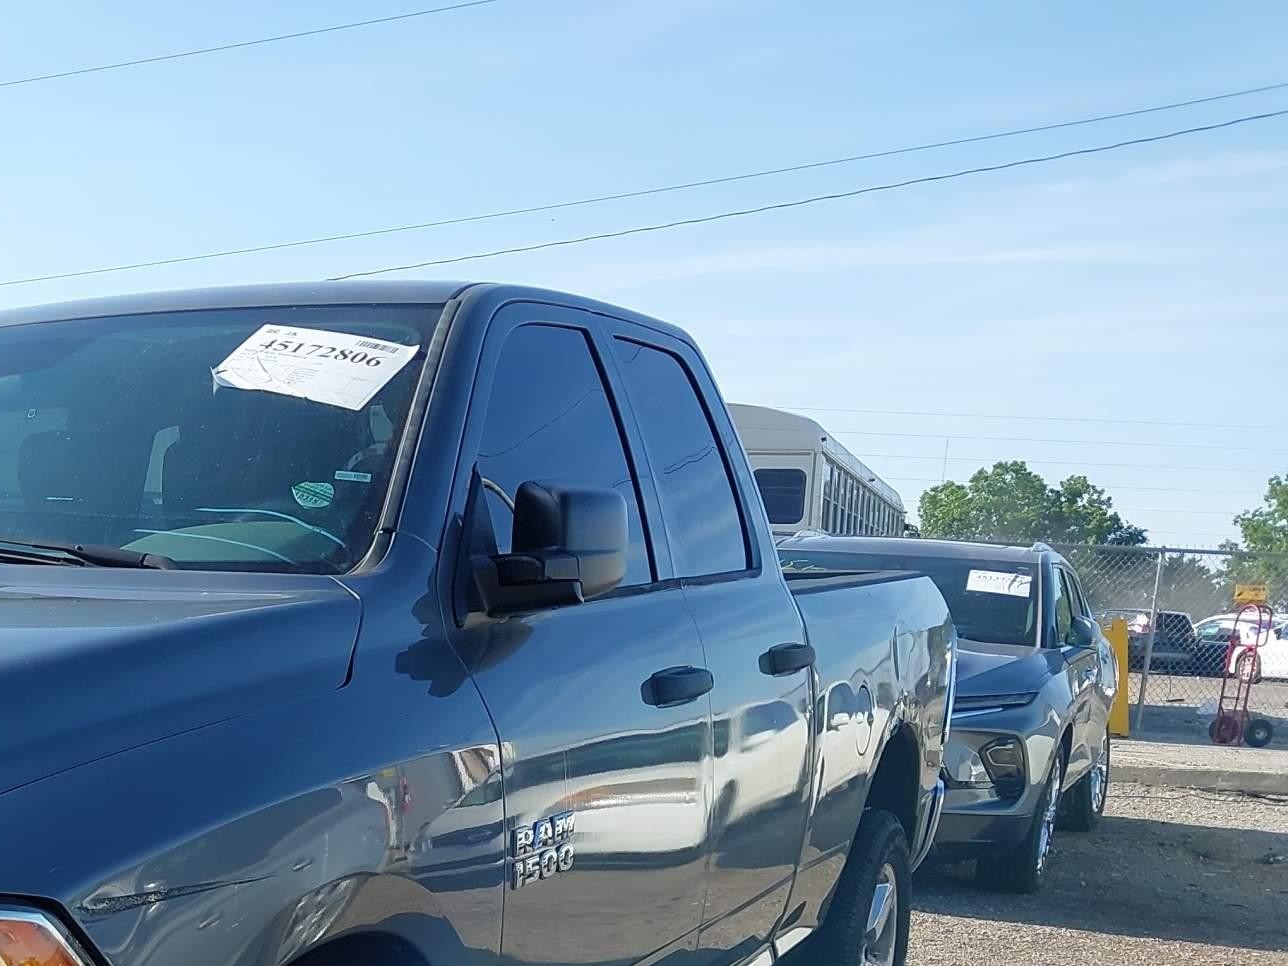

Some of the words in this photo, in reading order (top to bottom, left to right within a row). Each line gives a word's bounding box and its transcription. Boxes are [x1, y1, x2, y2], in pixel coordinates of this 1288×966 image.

[259, 338, 384, 367] 45172806
[512, 811, 575, 857] RAM
[512, 843, 574, 889] 1500
